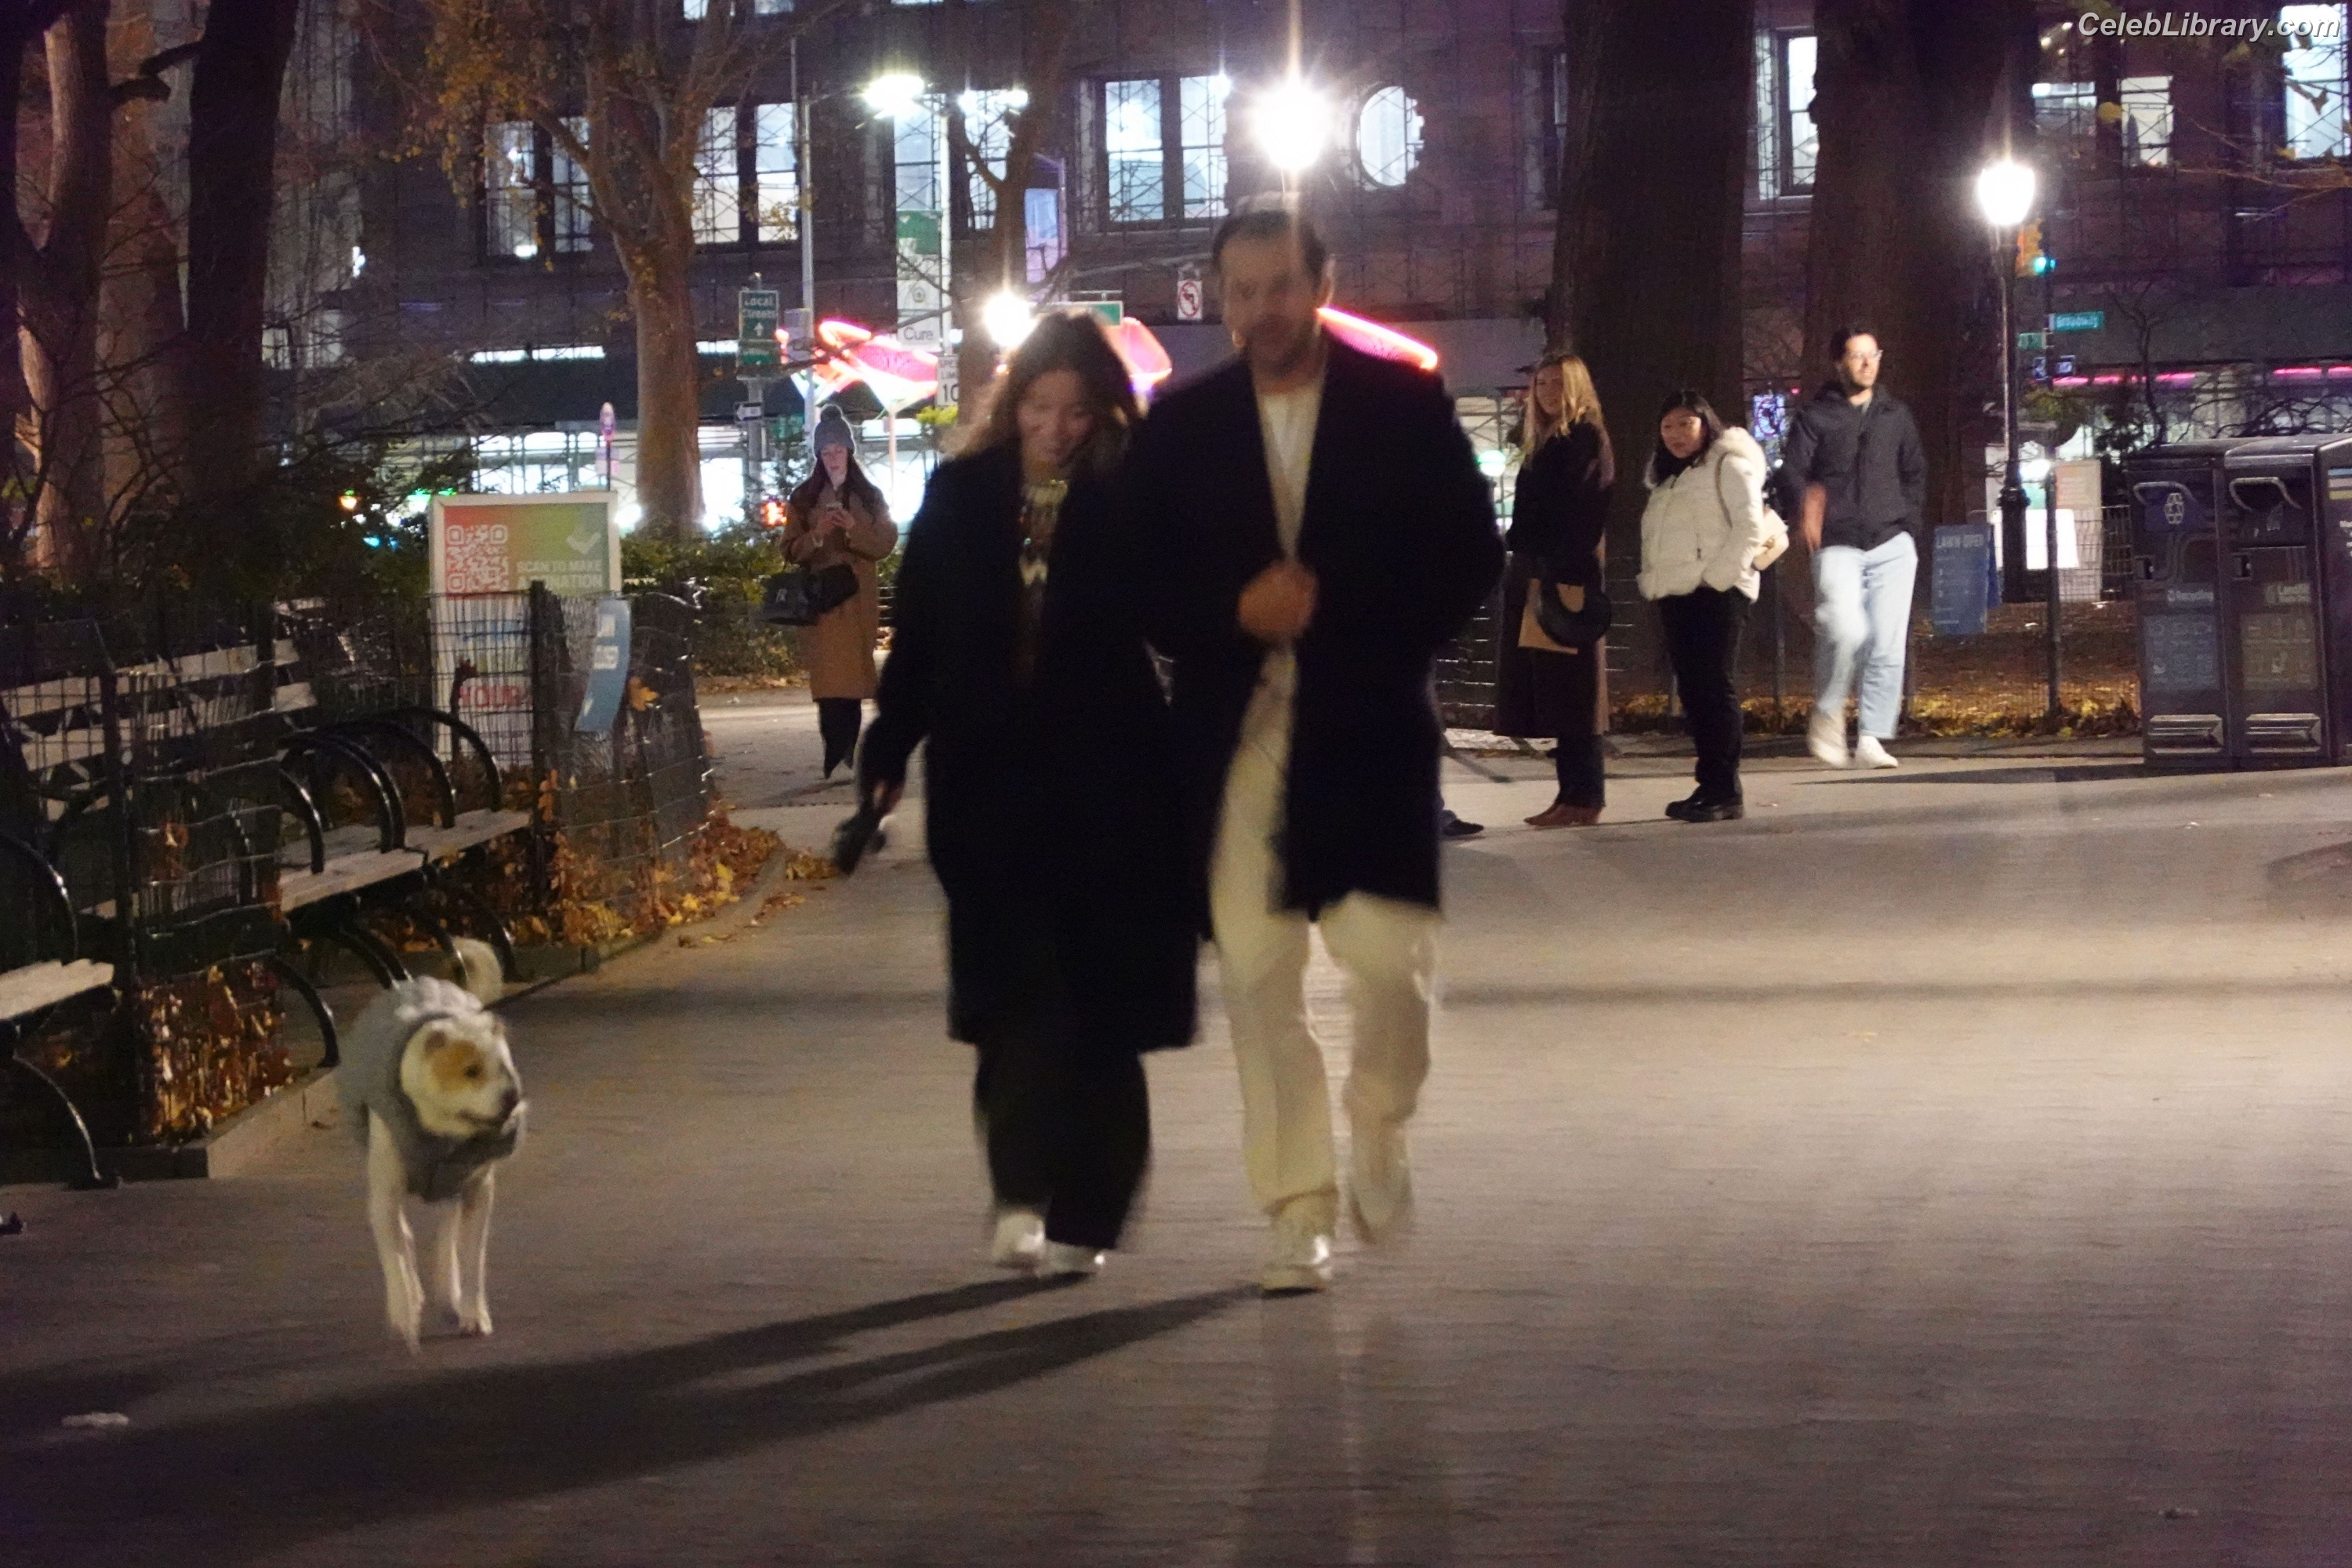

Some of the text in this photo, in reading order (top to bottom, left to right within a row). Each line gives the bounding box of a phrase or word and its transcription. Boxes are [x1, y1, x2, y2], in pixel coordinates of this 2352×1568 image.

[744, 296, 774, 306] Local
[903, 327, 934, 340] Cure
[517, 560, 602, 572] SCAN TO MAKE
